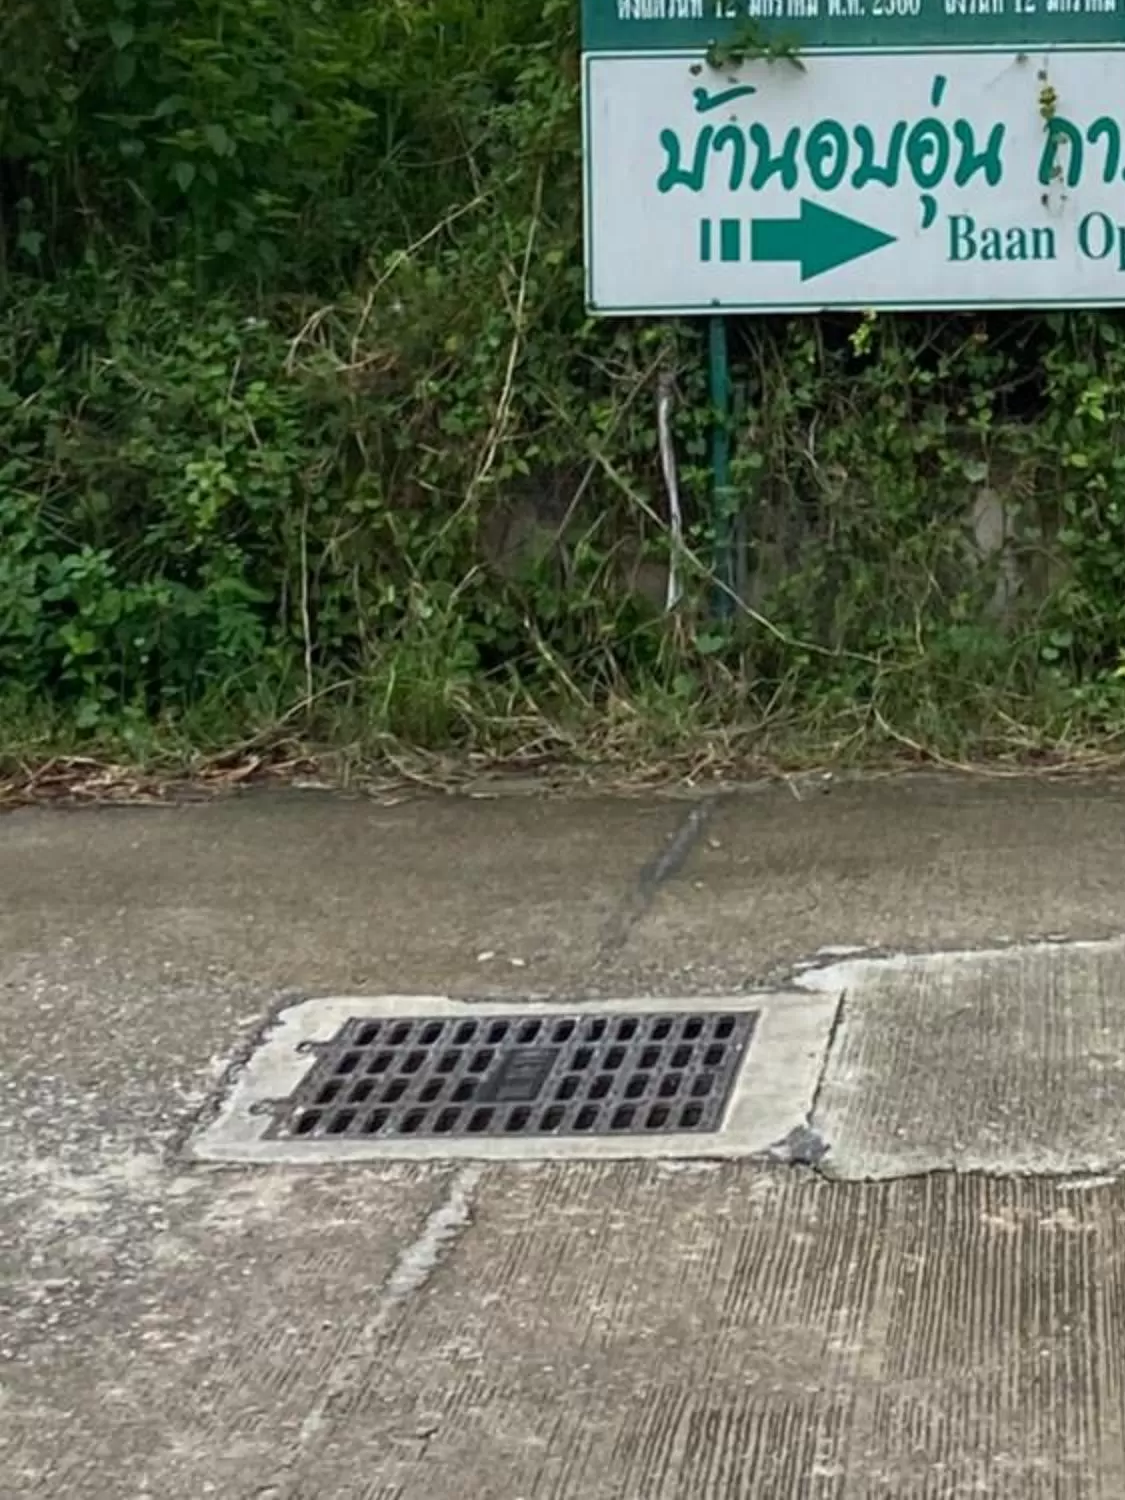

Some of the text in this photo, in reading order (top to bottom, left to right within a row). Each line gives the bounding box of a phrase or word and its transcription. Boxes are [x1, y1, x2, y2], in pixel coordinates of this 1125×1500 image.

[656, 74, 1006, 229] บ้านอบอุ่น
[947, 213, 1057, 262] Baan
